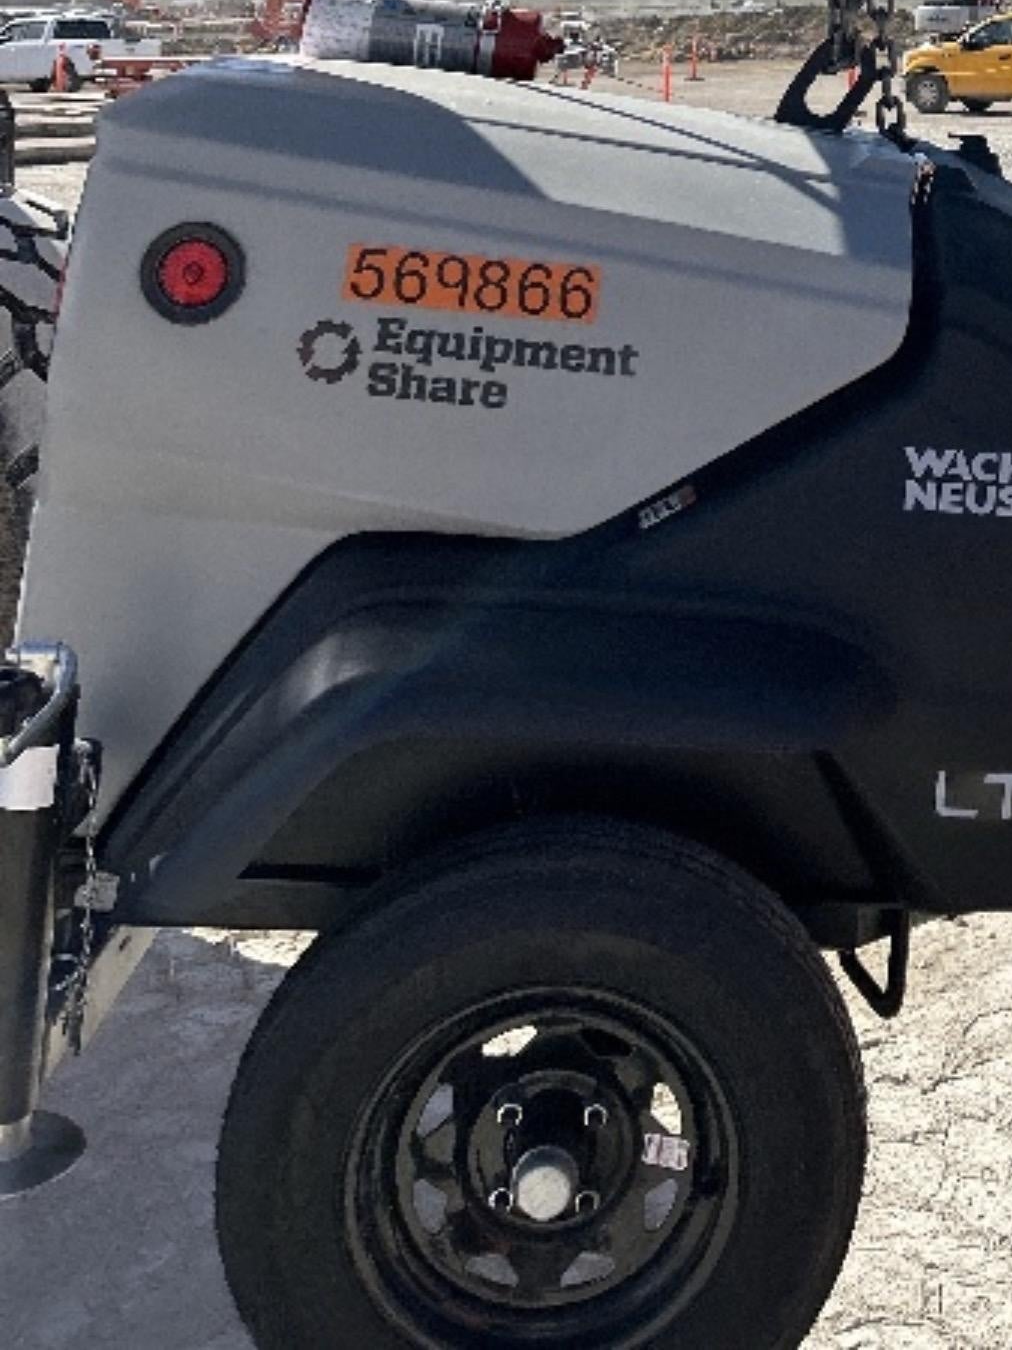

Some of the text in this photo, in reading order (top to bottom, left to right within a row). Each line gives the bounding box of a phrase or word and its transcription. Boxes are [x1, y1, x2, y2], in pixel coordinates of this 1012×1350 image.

[350, 248, 595, 319] 569866
[373, 316, 640, 376] Equipment
[366, 362, 508, 409] Share
